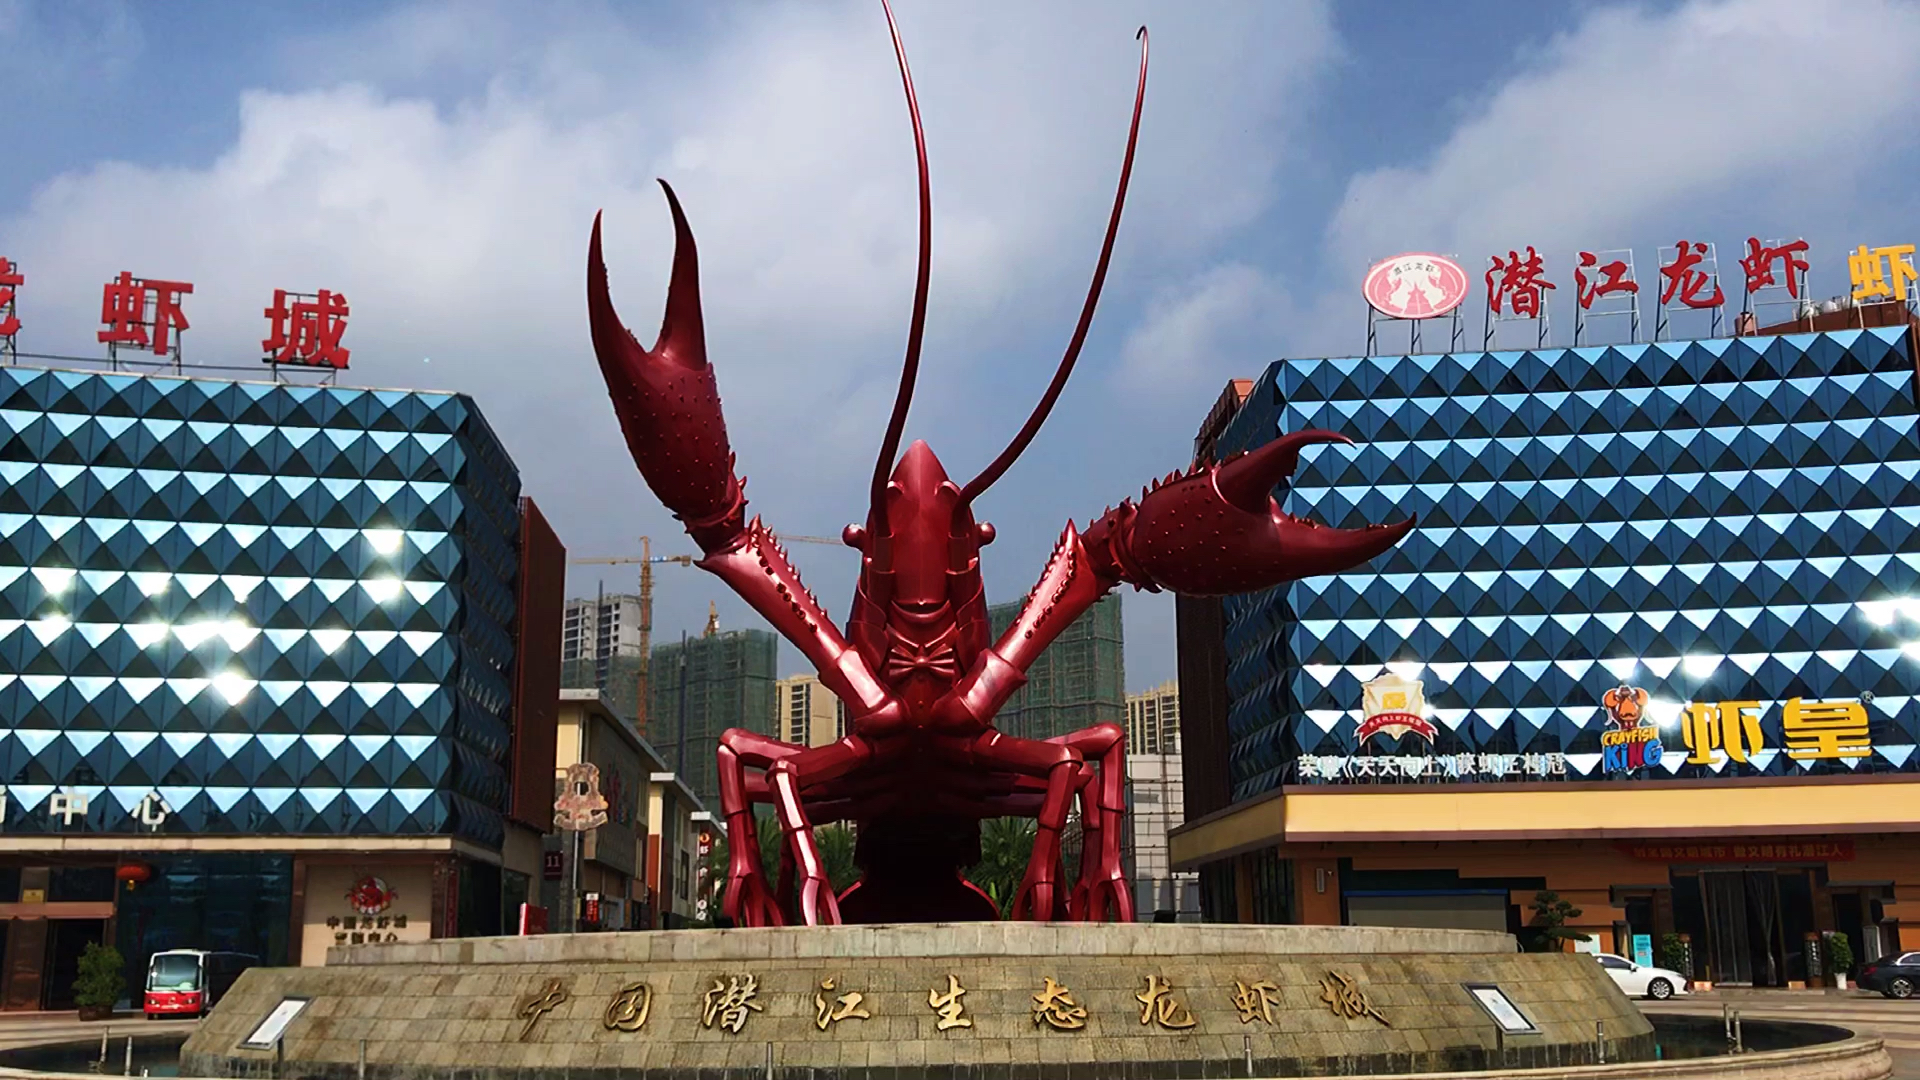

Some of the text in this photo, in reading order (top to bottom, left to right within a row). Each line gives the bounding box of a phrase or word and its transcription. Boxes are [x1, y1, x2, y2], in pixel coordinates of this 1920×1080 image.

[1484, 237, 1809, 318] 潜江龙虾
[1848, 244, 1918, 301] 虾
[1601, 726, 1659, 746] CRAYFISH
[1681, 697, 1871, 764] 虾皇
[546, 855, 561, 867] 11
[519, 970, 1391, 1042] 中国潜江生态龙虾城
